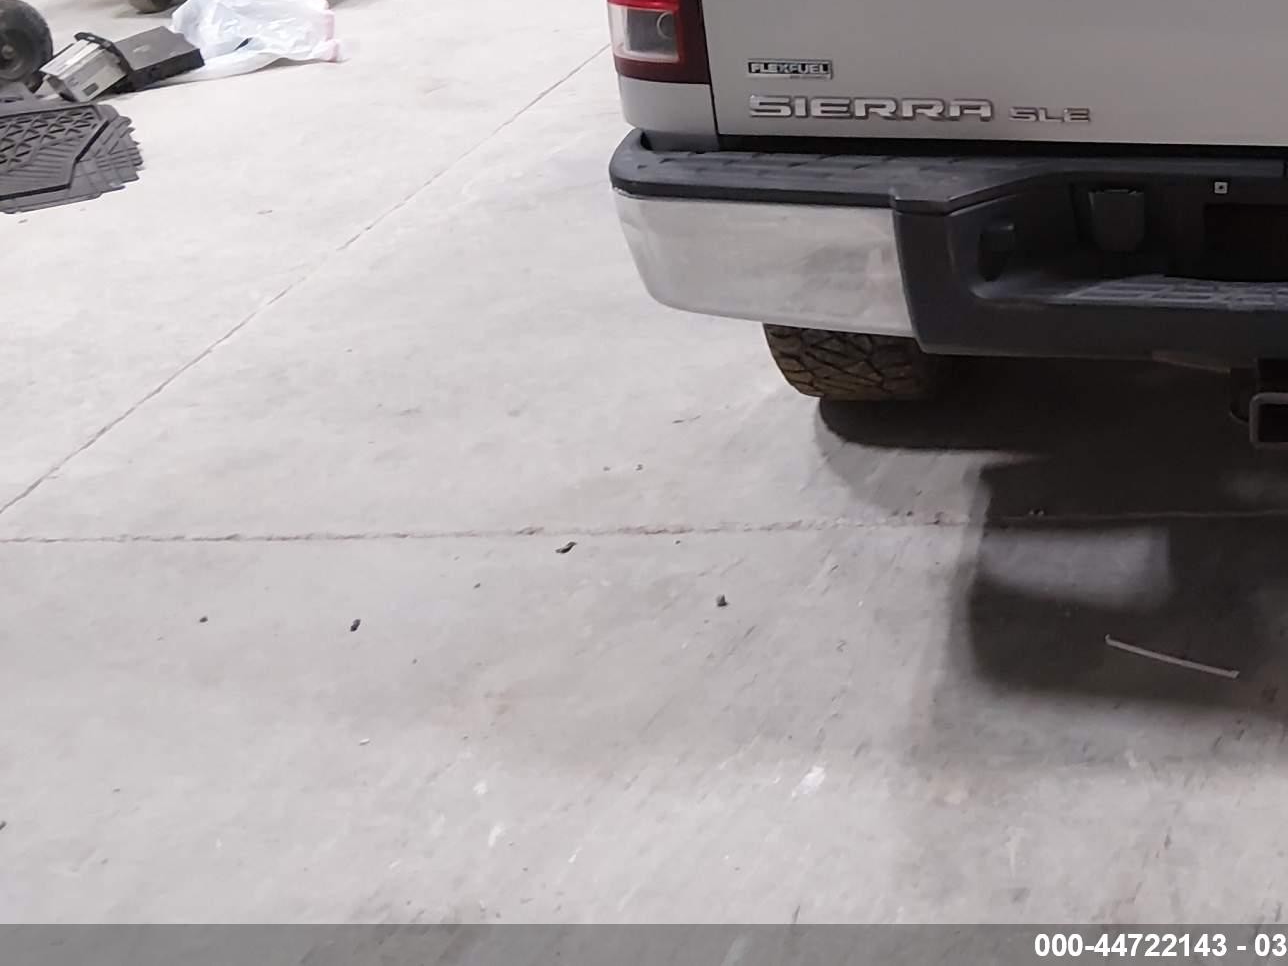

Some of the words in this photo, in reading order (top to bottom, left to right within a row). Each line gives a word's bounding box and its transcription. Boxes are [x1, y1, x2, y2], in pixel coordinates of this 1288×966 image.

[749, 61, 830, 74] FLEXFUEL
[749, 95, 994, 121] SIERRA
[1009, 106, 1092, 123] SLE
